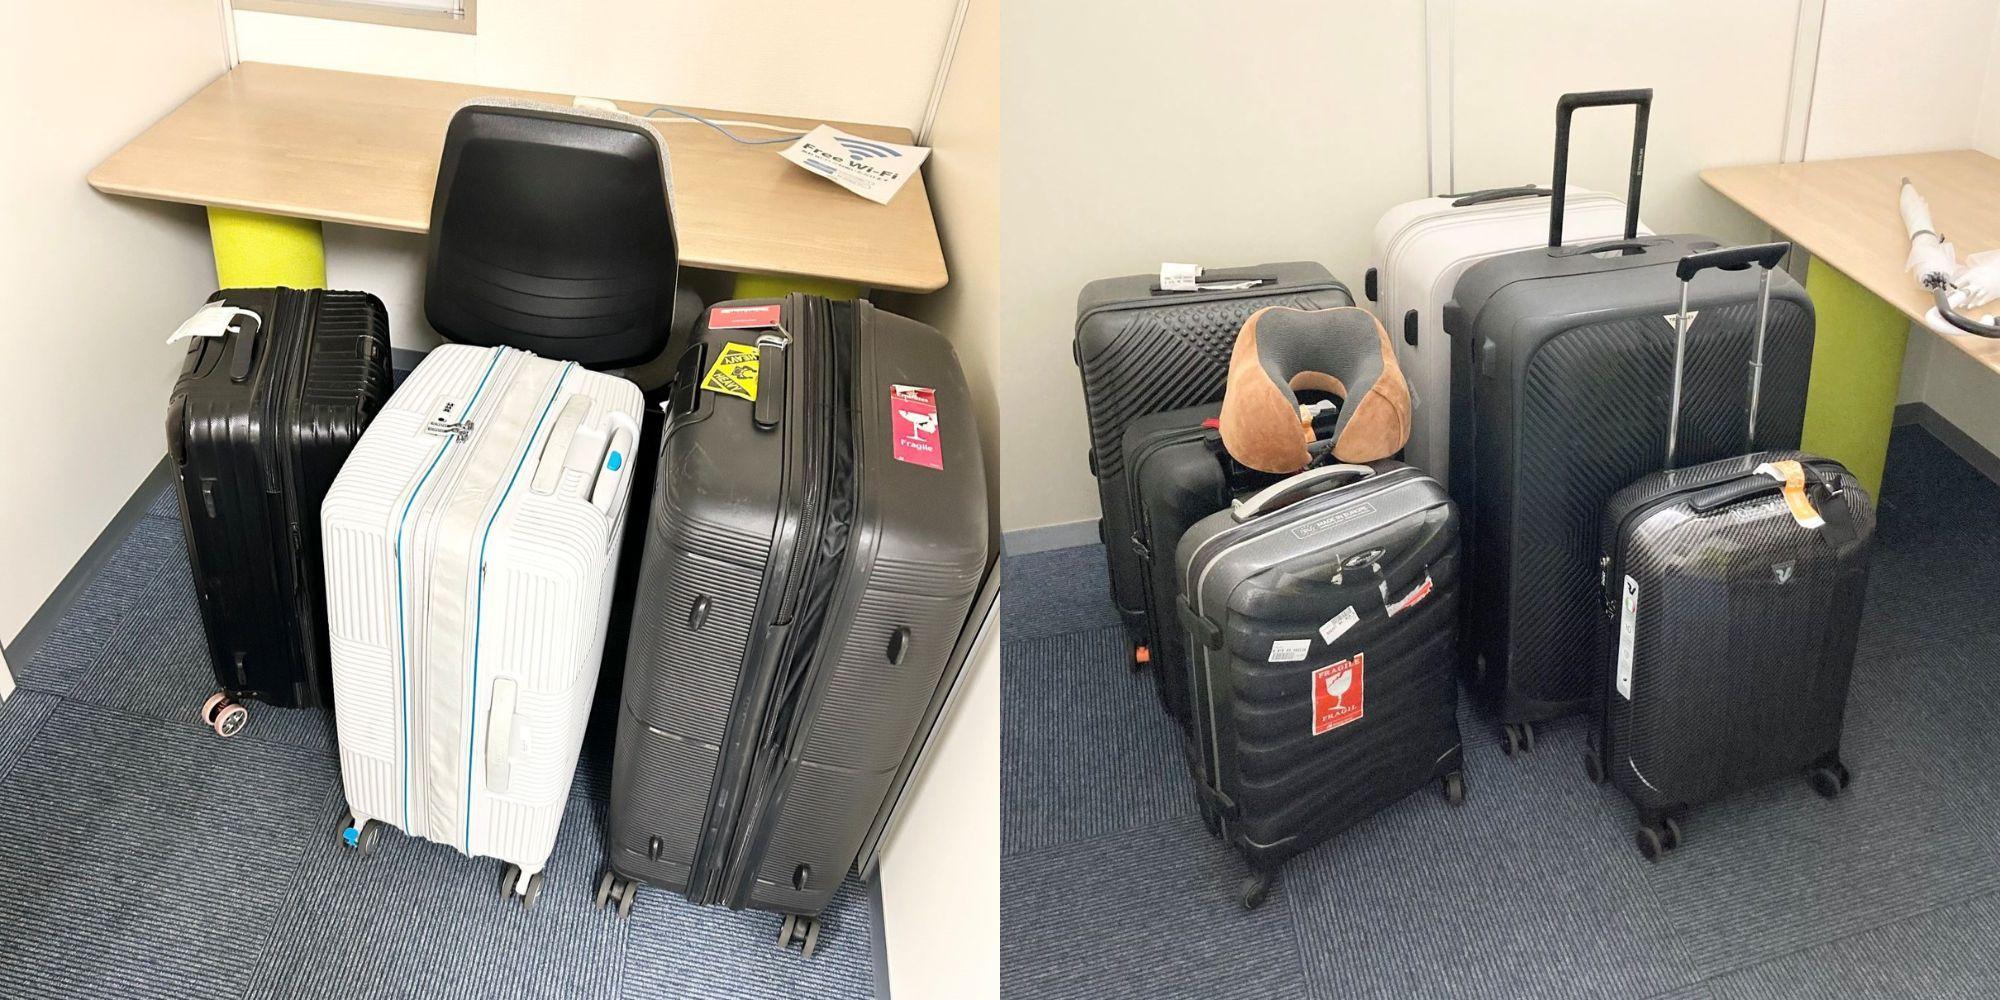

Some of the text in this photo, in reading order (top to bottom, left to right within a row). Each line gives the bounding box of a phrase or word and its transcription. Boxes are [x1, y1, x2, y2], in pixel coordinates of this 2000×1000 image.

[802, 143, 843, 162] Free
[849, 161, 898, 180] Wi-Fi
[725, 354, 757, 364] HEAVY
[714, 373, 743, 391] HEAVY
[900, 439, 934, 452] Fragile
[1318, 658, 1361, 679] FRAGILE
[1322, 704, 1357, 722] FRAGIL
